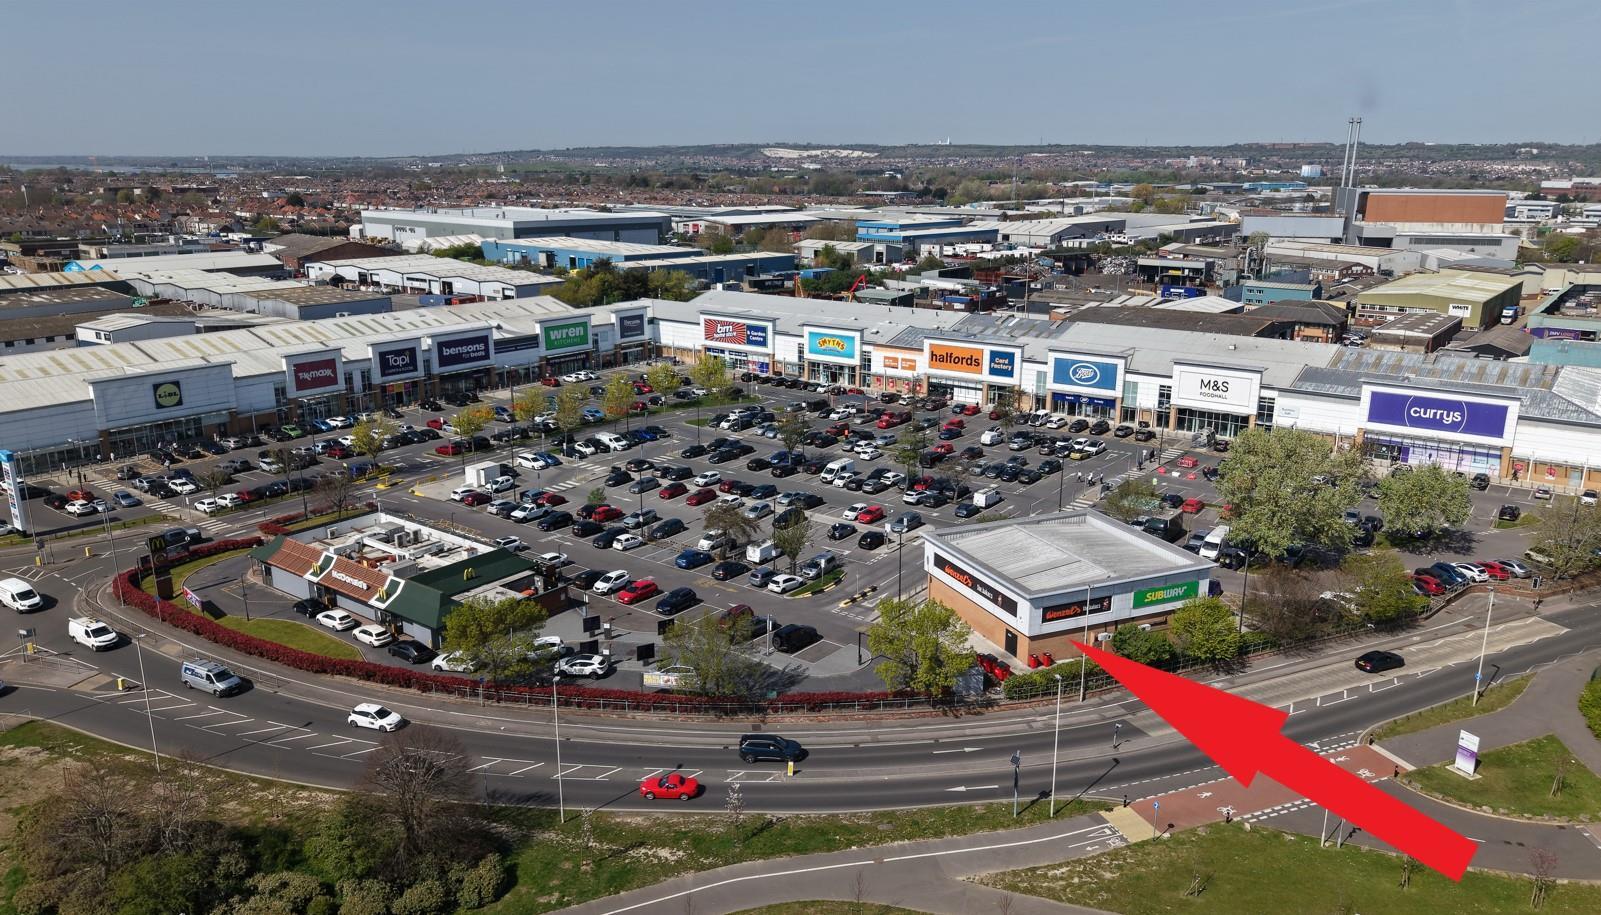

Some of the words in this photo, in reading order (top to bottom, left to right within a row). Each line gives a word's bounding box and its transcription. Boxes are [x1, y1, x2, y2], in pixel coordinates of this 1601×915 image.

[550, 325, 584, 340] wren
[443, 343, 485, 356] bensons
[818, 338, 845, 351] SMYTHS
[386, 354, 409, 367] Tapi
[930, 351, 980, 367] halfords
[991, 363, 1012, 371] Factory
[1074, 368, 1094, 379] Boots
[1200, 379, 1229, 393] M&S
[1200, 391, 1228, 400] FOODHALL
[1410, 407, 1461, 424] currys
[1144, 586, 1187, 602] SUBWAY
